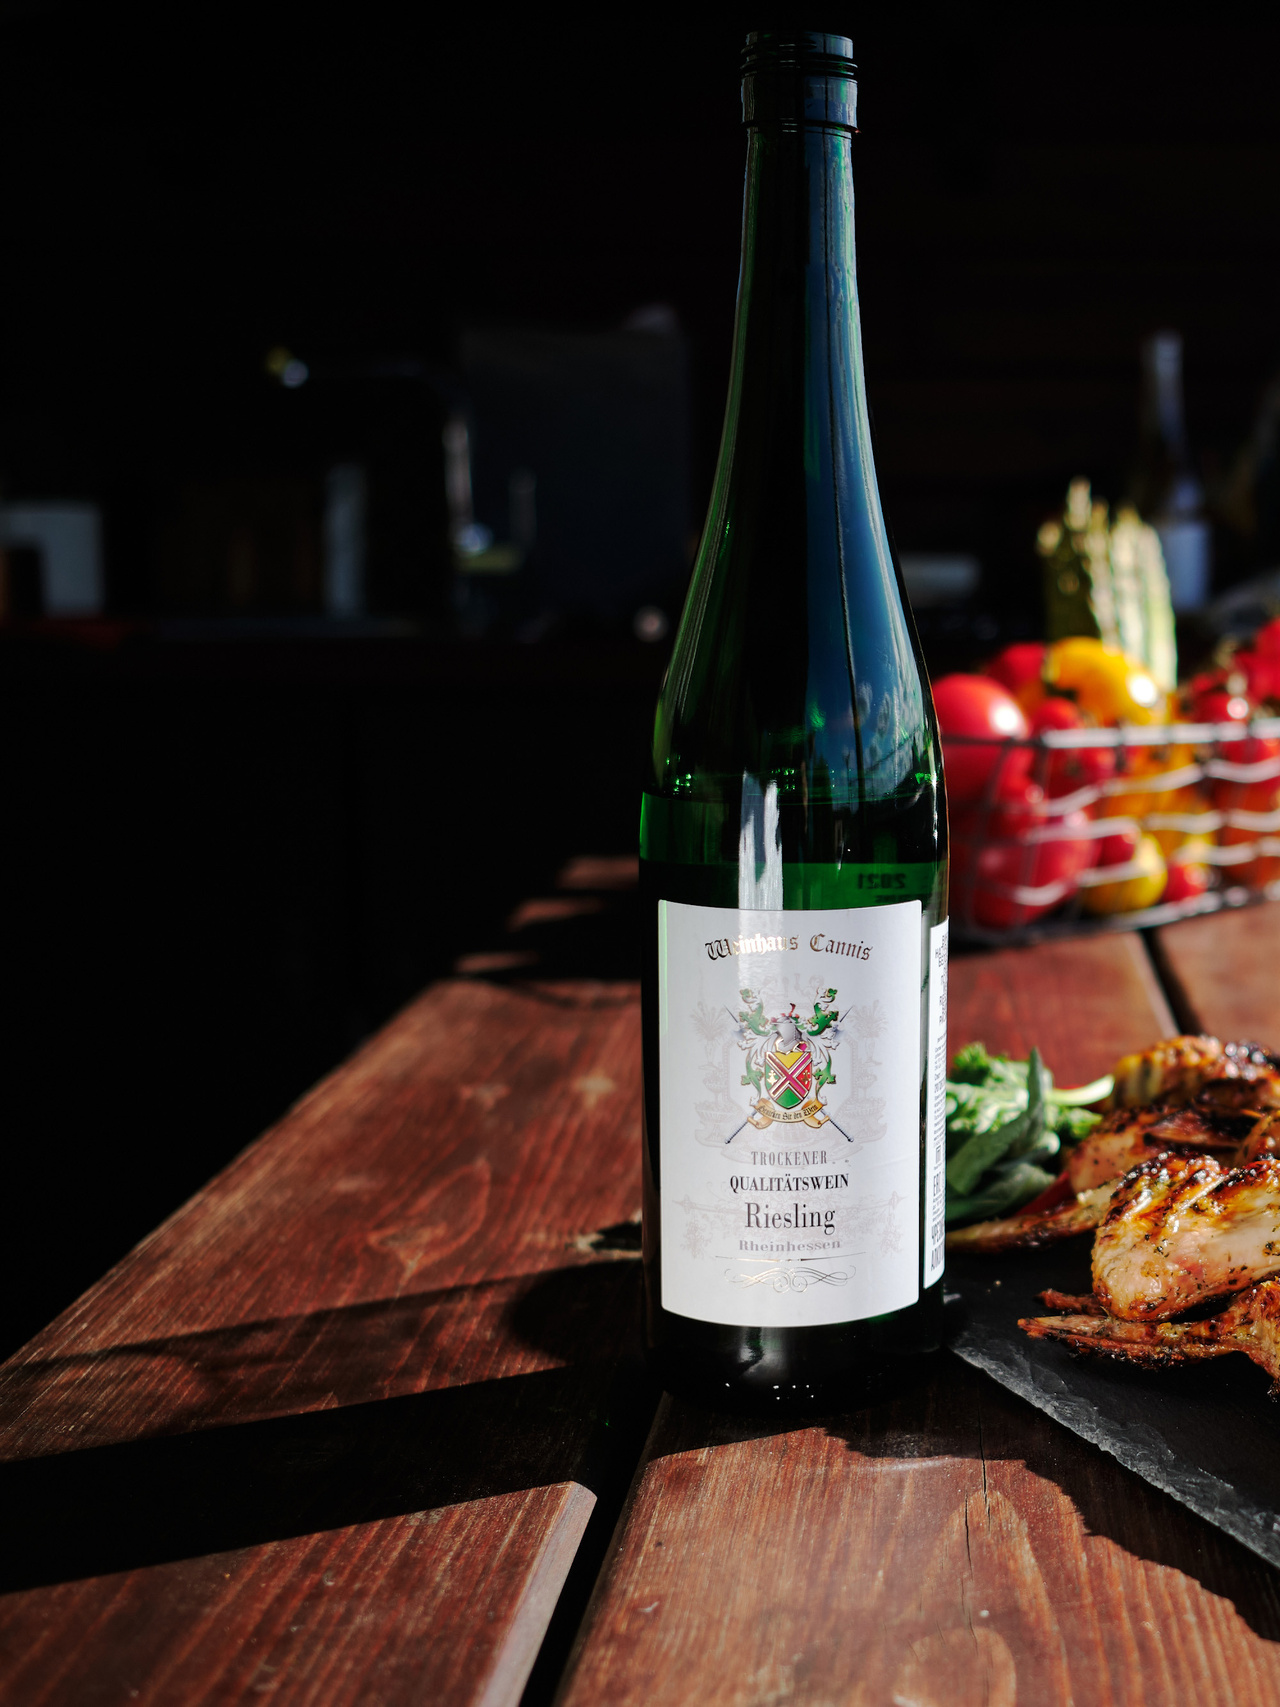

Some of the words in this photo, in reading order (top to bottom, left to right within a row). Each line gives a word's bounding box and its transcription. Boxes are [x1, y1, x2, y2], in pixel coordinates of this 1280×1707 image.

[704, 932, 800, 961] Weinhaus
[809, 933, 874, 961] Cannis
[751, 1150, 827, 1166] TROCKENER
[730, 1173, 849, 1194] QUALITÄTSWEIN
[744, 1202, 836, 1236] Riesling
[739, 1239, 841, 1252] Rheinhessen
